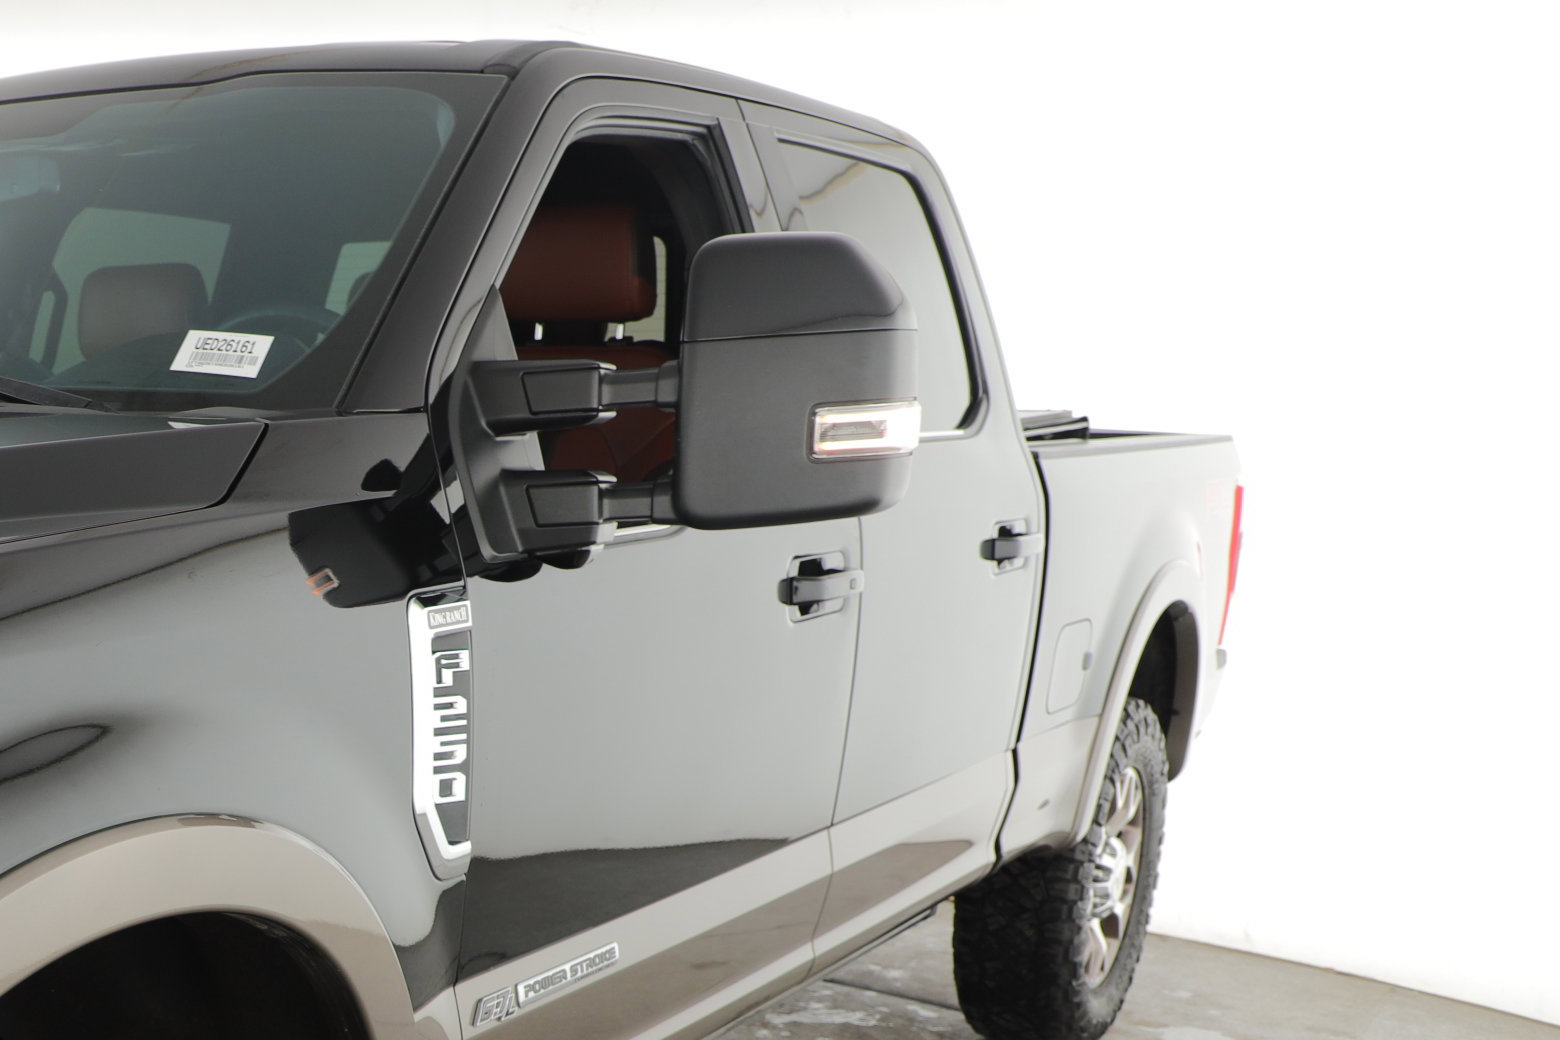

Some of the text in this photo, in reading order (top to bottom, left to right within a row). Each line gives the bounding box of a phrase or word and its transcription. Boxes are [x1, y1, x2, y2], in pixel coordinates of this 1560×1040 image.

[194, 336, 257, 354] UED26161
[428, 606, 468, 627] KING RANCH
[523, 968, 568, 999] POWER
[569, 946, 617, 978] STROKE
